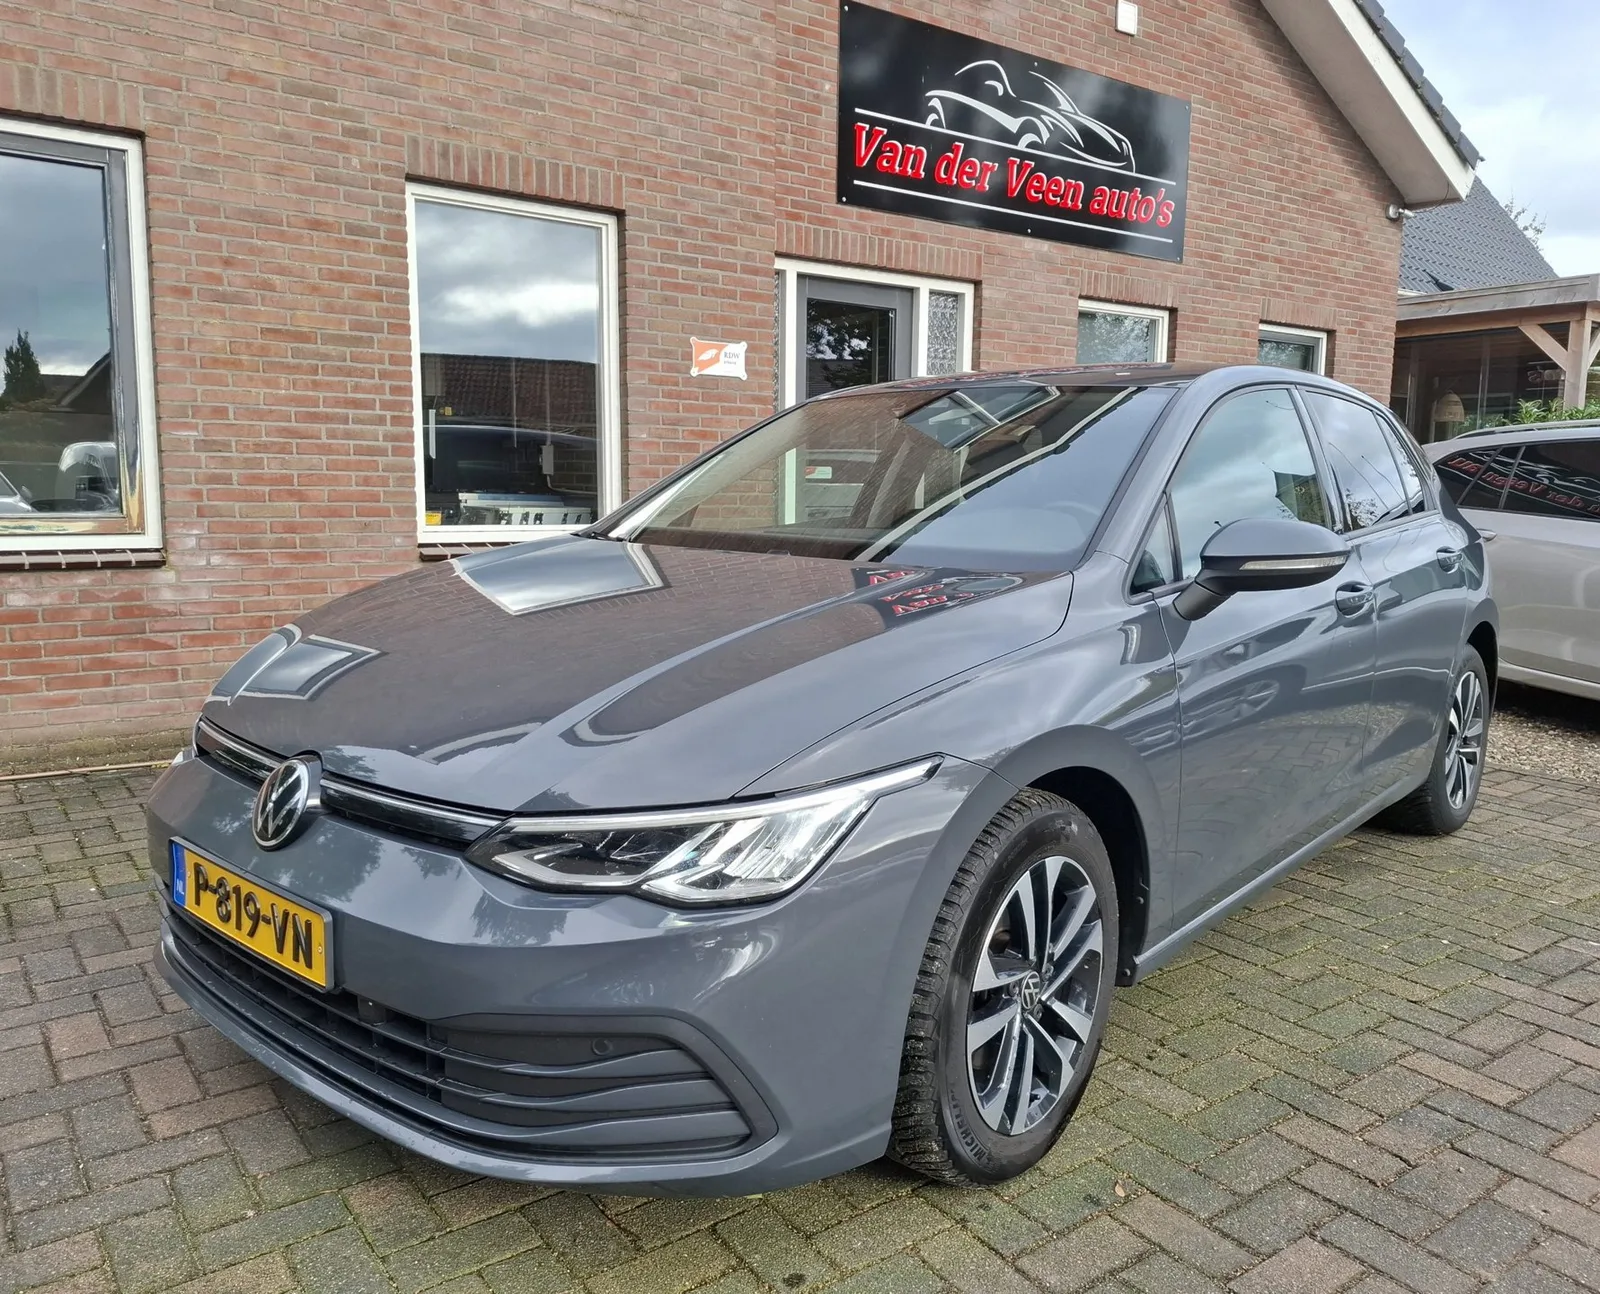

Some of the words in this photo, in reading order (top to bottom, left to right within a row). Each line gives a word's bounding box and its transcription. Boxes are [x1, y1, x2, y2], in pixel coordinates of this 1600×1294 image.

[854, 122, 928, 180] Van
[935, 142, 999, 192] der
[1007, 157, 1085, 211] Veen
[1089, 186, 1176, 228] auto's
[175, 878, 185, 896] NL
[193, 861, 313, 970] P-819-VN
